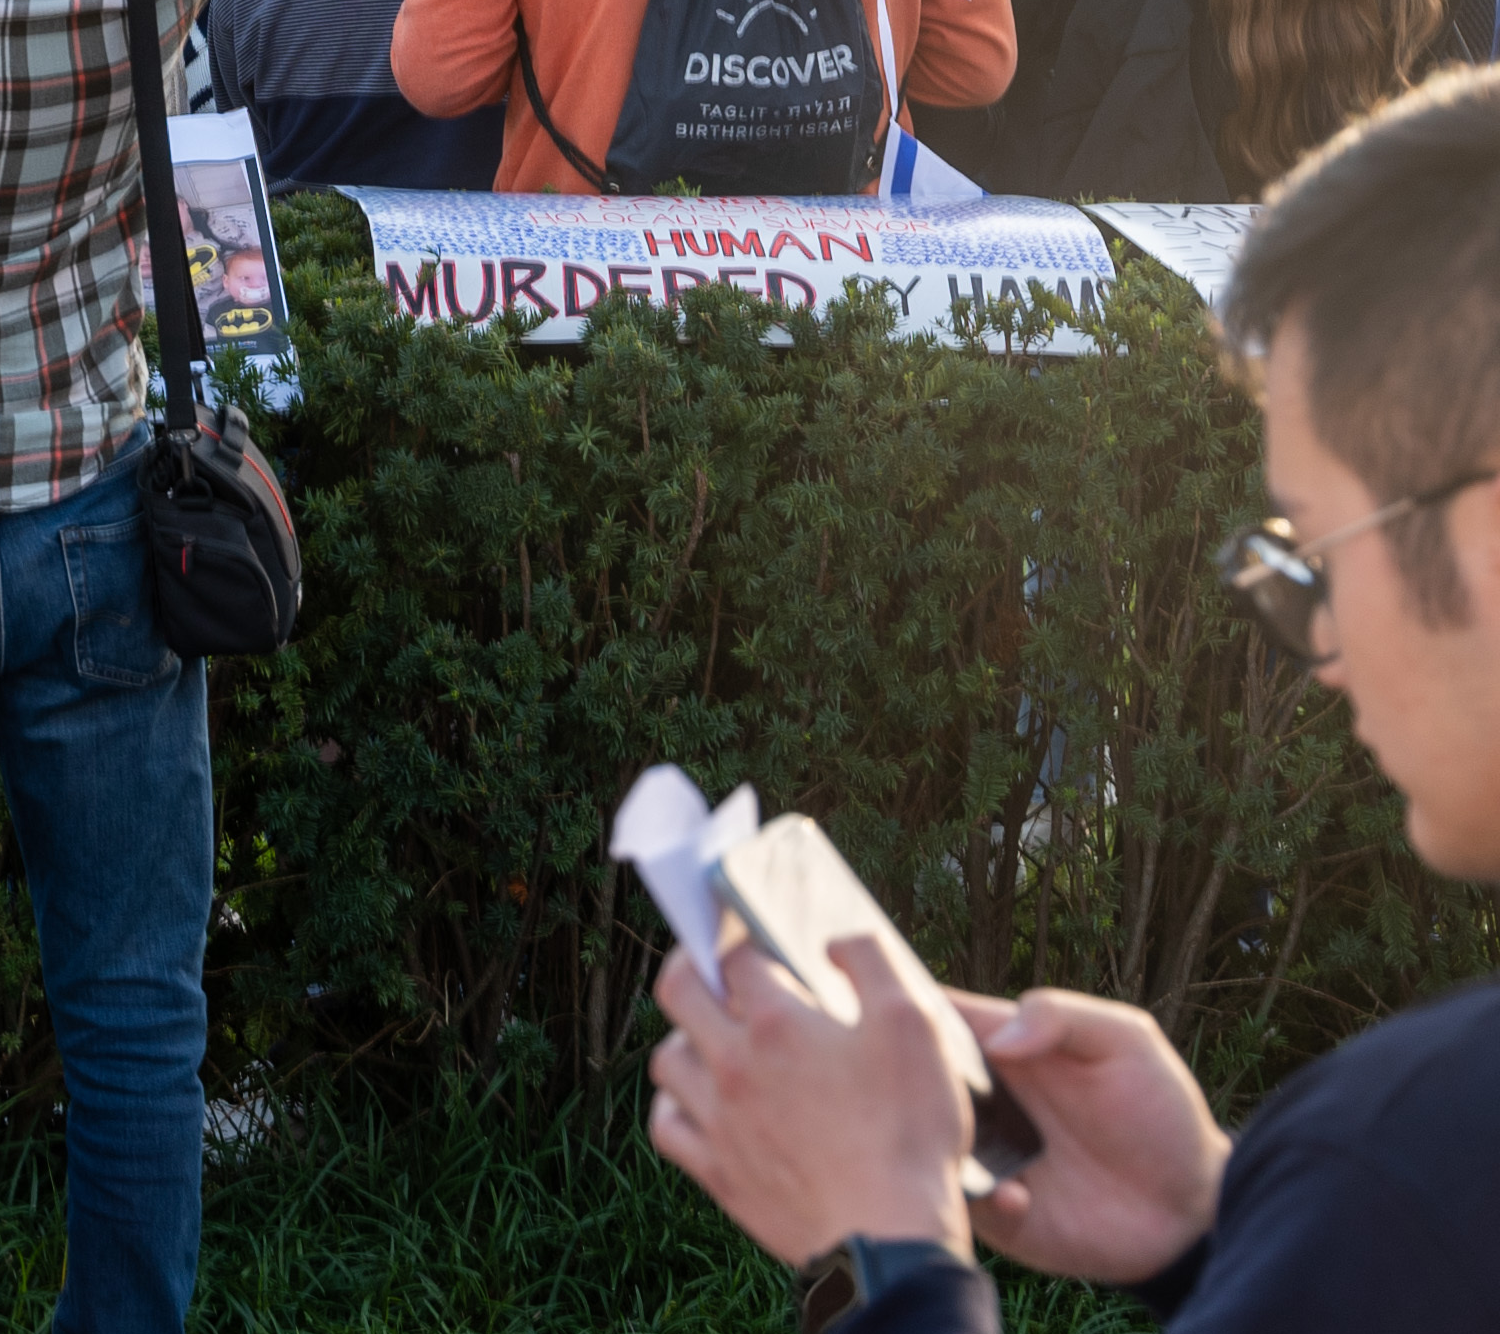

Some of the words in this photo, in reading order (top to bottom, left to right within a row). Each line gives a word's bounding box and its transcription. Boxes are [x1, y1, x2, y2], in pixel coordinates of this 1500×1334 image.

[684, 44, 859, 88] DISCOVER
[700, 103, 768, 121] TAGLIT
[676, 122, 793, 140] BIRTHRIGHT
[529, 211, 738, 229] HOLOCAUST
[763, 215, 935, 233] SURVIVOR
[643, 228, 874, 262] HUMAN
